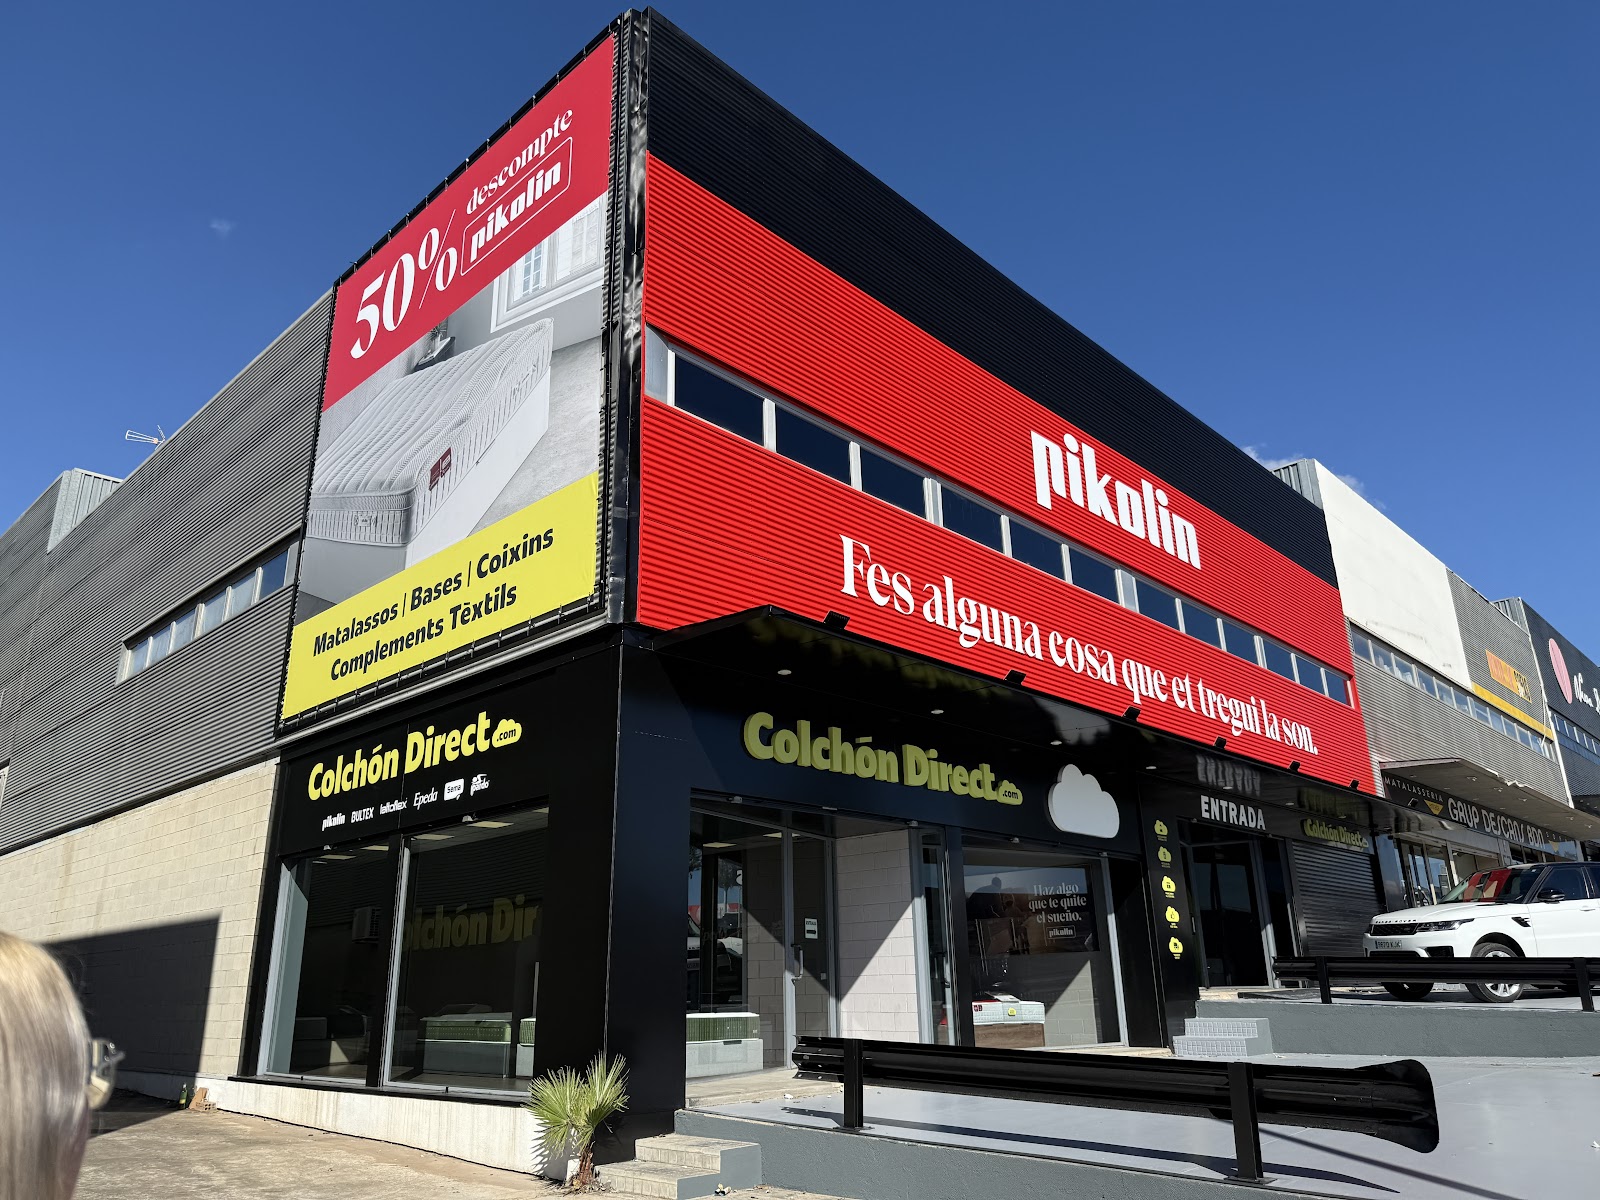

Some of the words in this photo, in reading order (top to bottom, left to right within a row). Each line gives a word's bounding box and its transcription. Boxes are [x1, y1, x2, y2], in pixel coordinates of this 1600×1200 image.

[467, 109, 573, 215] descompte
[469, 161, 562, 263] pikolin
[350, 208, 458, 359] 50%
[1030, 431, 1201, 570] pikolin
[312, 603, 399, 657] Matalassos
[410, 568, 462, 611] Bases
[476, 527, 554, 578] Coixins
[330, 614, 444, 682] Complements
[839, 534, 915, 615] Fes
[922, 575, 1044, 661] alguna
[1049, 630, 1117, 686] cosa
[1121, 658, 1168, 705] que
[1171, 673, 1196, 712] et
[1197, 678, 1260, 737] tregui
[1261, 699, 1282, 741] la
[1282, 716, 1319, 756] son.
[307, 744, 400, 801] Colchón
[404, 711, 491, 774] Direct
[496, 728, 517, 742] .com
[743, 711, 899, 783] Colchón
[902, 743, 998, 801] Direct
[1002, 789, 1019, 800] .com
[1385, 776, 1444, 802] MATALASSERIA
[351, 807, 375, 823] BULTEX
[413, 787, 439, 810] Epeda
[1201, 795, 1266, 831] ENTRADA
[1303, 818, 1339, 842] Colchón
[1447, 797, 1480, 830] GRUP
[1481, 809, 1524, 844] DESCANS
[1028, 899, 1048, 912] que
[1049, 897, 1059, 908] te
[1060, 894, 1087, 911] quite
[1033, 883, 1055, 897] Haz
[1056, 882, 1079, 897] algo
[1036, 911, 1046, 923] el
[1047, 910, 1082, 923] sueño.
